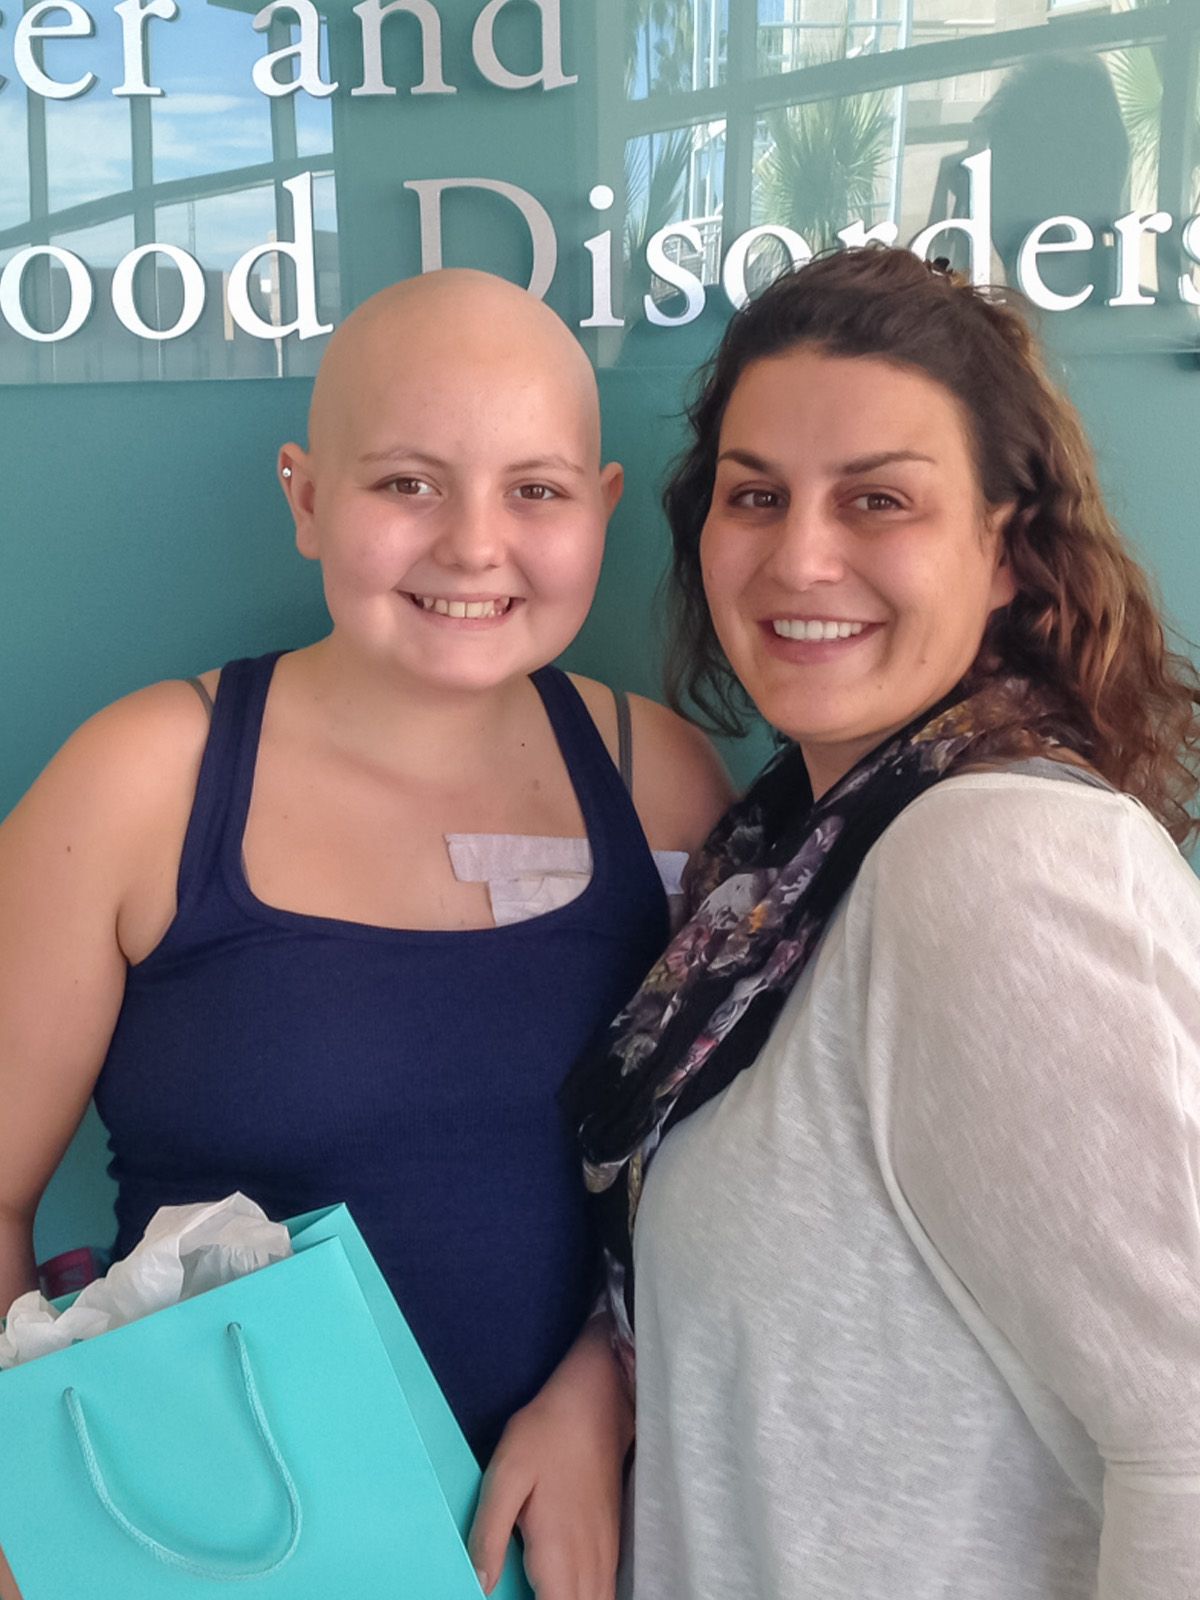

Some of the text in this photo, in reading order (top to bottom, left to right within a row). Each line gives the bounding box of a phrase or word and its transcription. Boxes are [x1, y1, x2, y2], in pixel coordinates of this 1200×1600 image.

[0, 0, 578, 99] er and
[0, 171, 334, 342] ood
